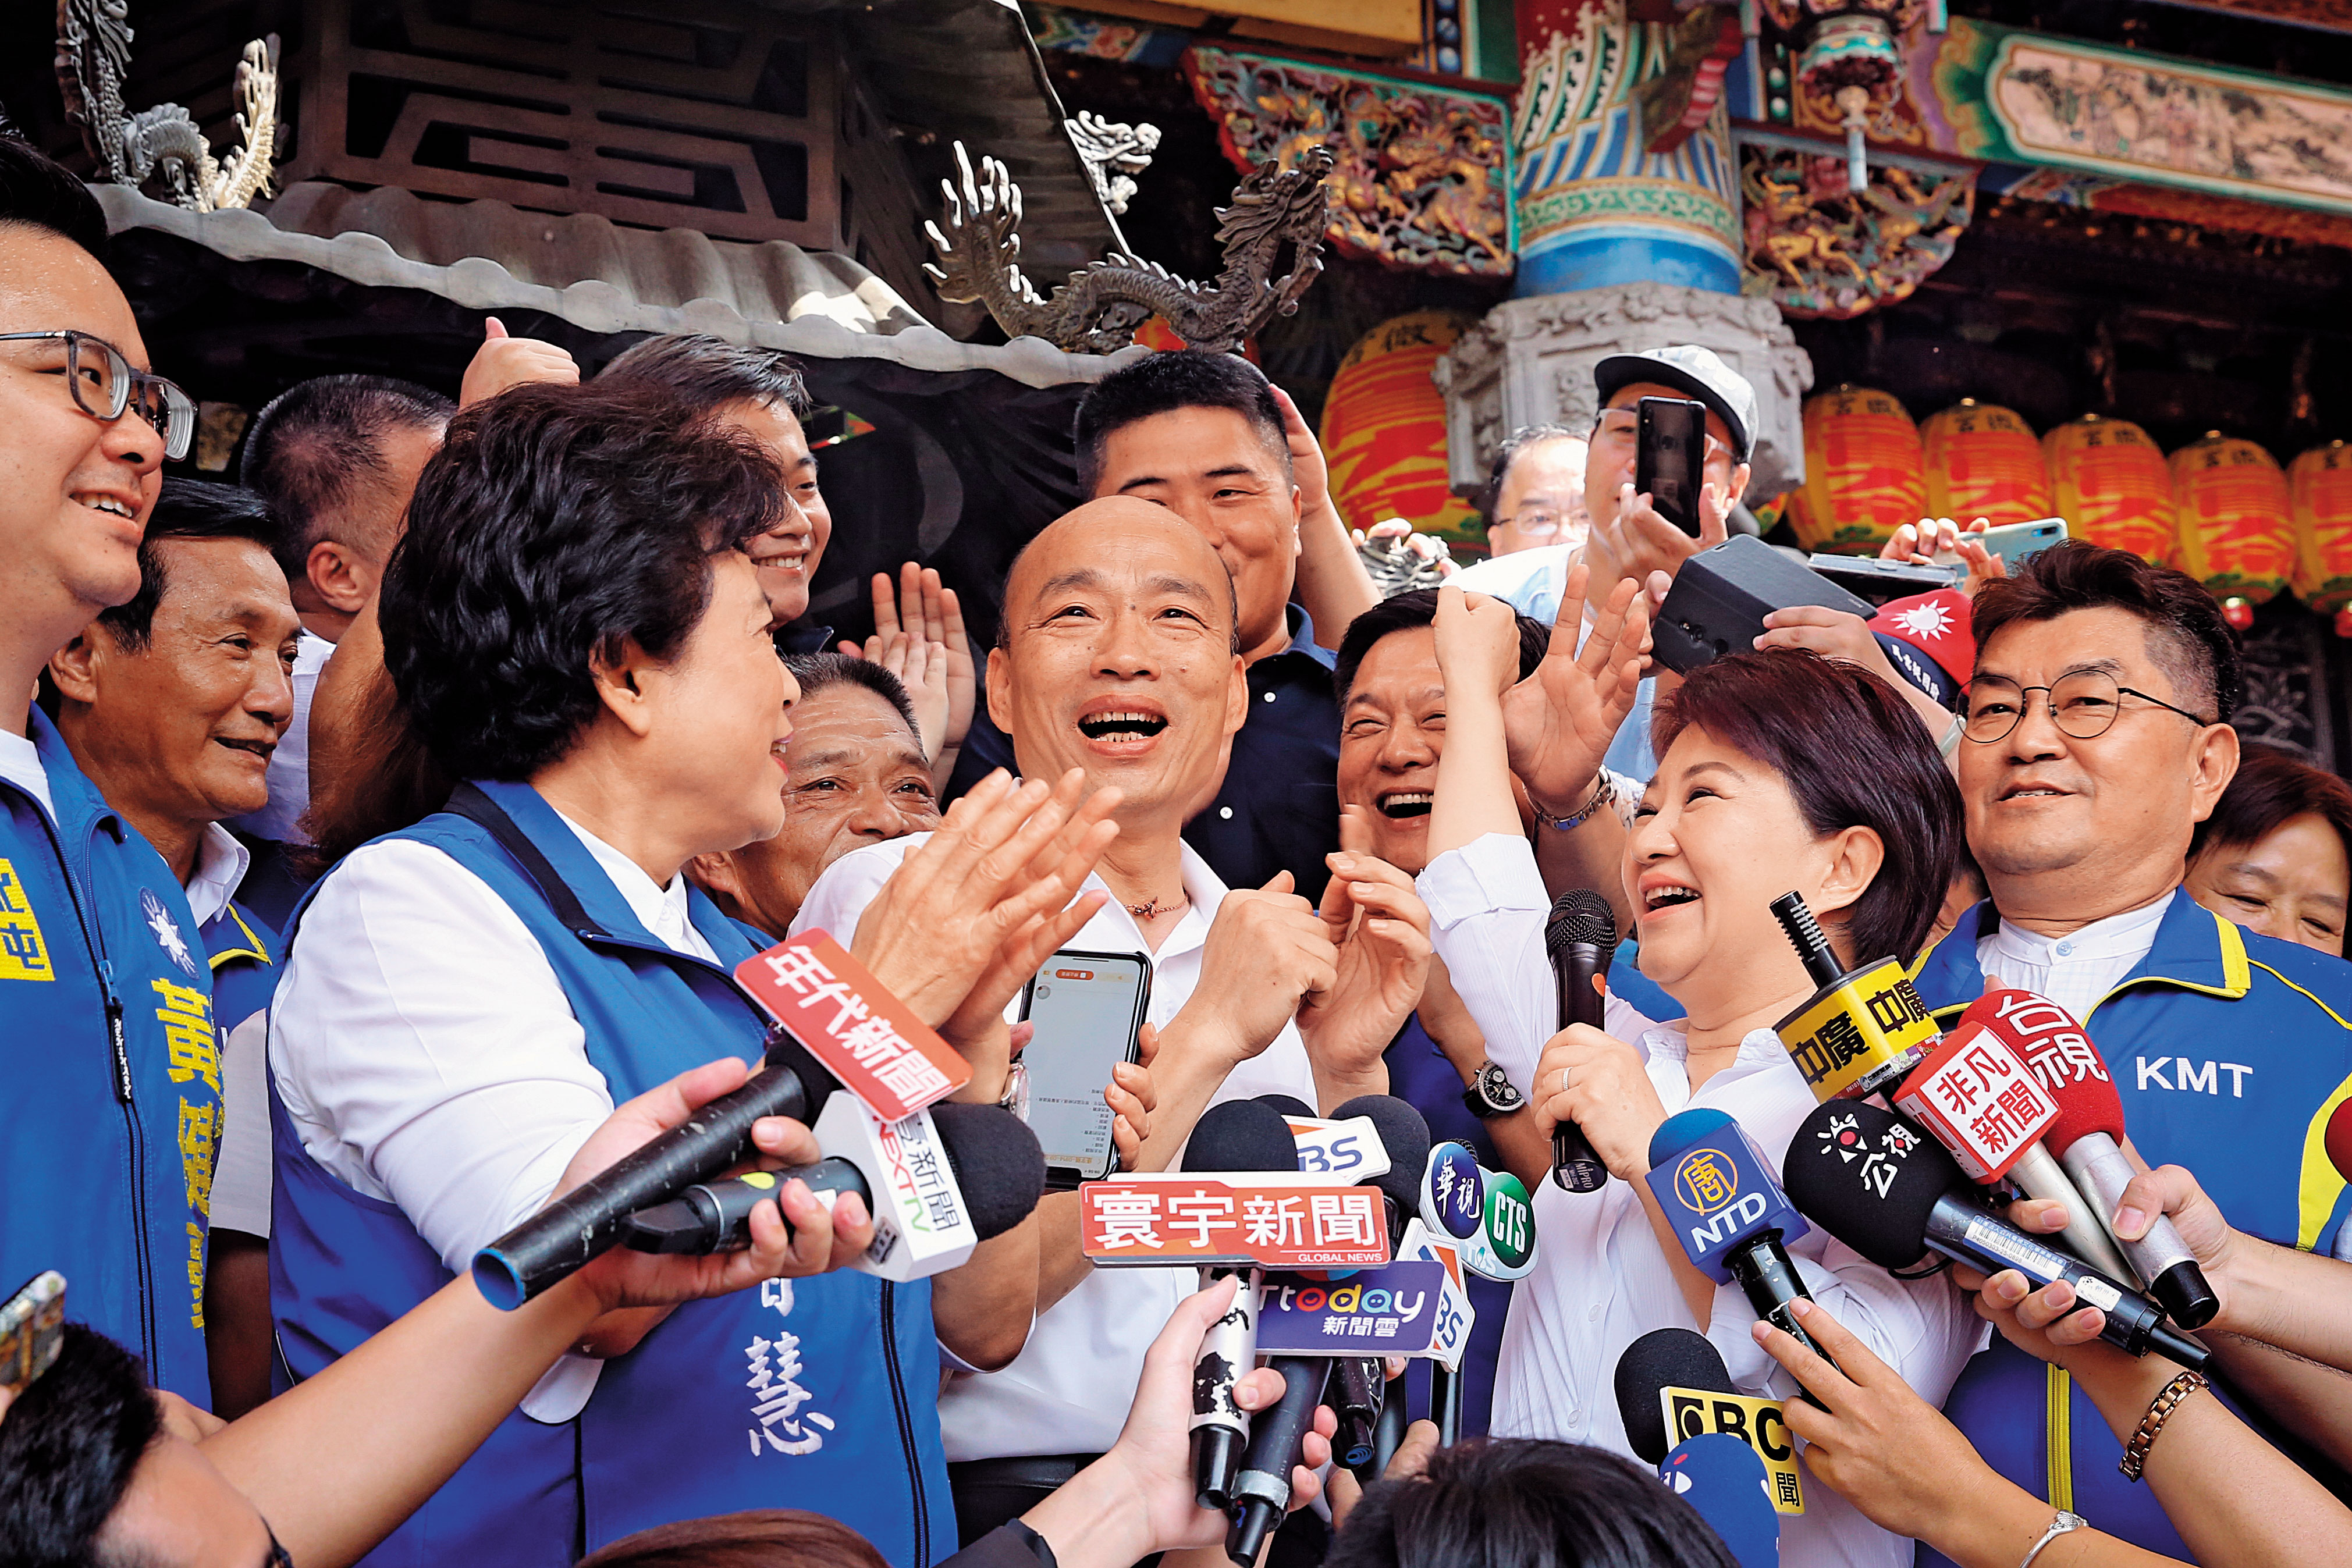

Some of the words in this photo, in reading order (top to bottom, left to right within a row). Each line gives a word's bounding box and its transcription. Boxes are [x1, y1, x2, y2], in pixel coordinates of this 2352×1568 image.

[764, 945, 953, 1112] 年代新聞
[1866, 978, 1931, 1033] 中廣
[1790, 1011, 1870, 1086] 中廣
[1995, 993, 2109, 1088] 台視
[1937, 1046, 2011, 1114] 非凡
[2136, 1056, 2253, 1098] KMT
[1970, 1078, 2045, 1154] 新聞
[1436, 1155, 1480, 1218] 華視
[1860, 1123, 1920, 1199] 公視
[1093, 1190, 1376, 1249] 寰宇新聞
[1493, 1191, 1527, 1253] CTS
[1692, 1193, 1766, 1253] NTD
[1298, 1253, 1345, 1262] GLOBAL
[1347, 1253, 1383, 1262] NEWS
[1322, 1315, 1399, 1337] 新聞雲
[1775, 1471, 1800, 1506] 聞
